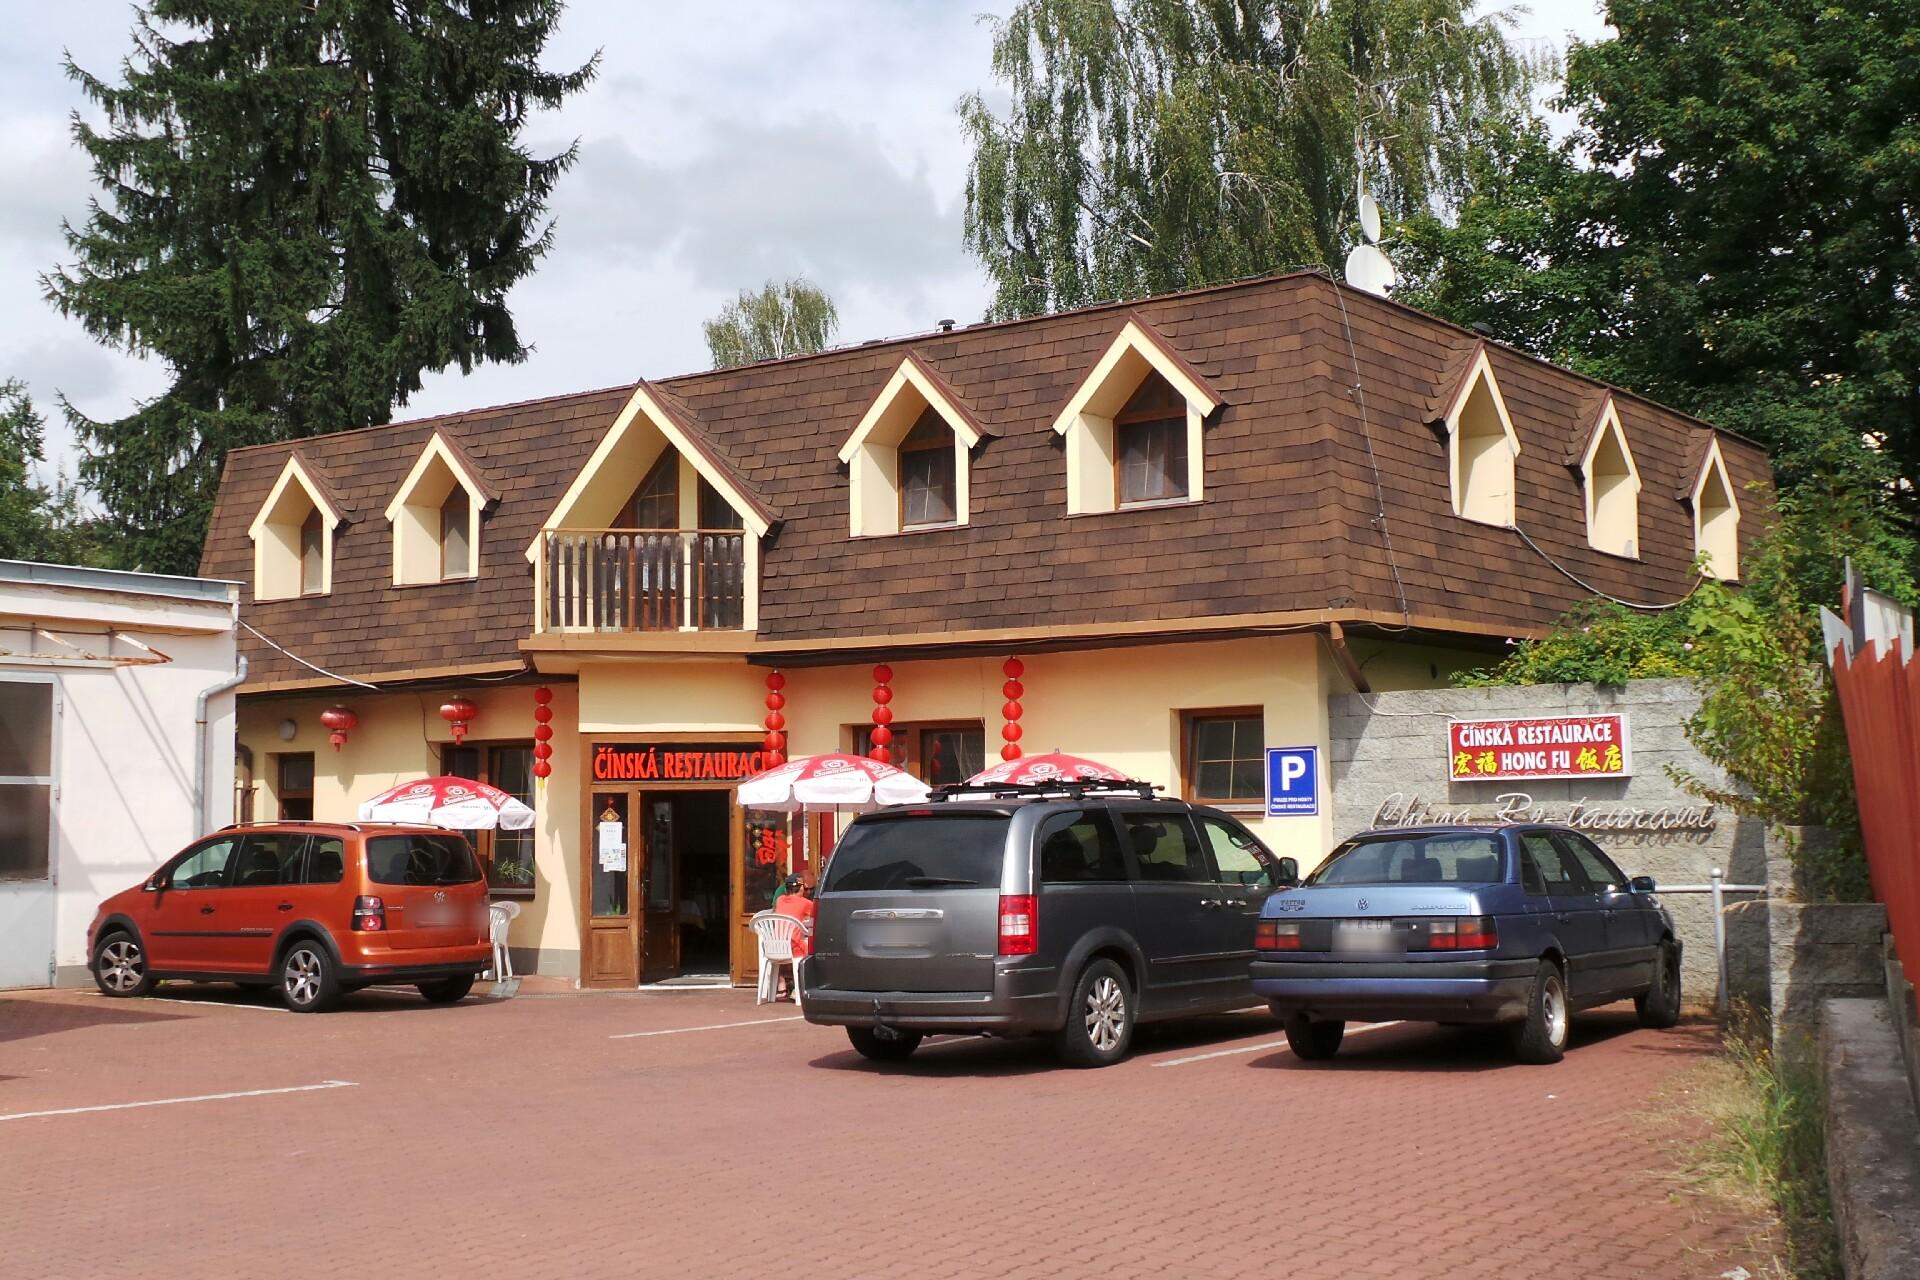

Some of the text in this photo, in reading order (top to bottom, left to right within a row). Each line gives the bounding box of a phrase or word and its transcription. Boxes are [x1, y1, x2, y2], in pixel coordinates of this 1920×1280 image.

[1459, 723, 1613, 748] ČÍNSKÁ RESTAURACE
[594, 747, 659, 779] ČÍNSKÁ
[1281, 755, 1306, 791] P
[1501, 752, 1547, 771] HONG
[1552, 750, 1571, 769] FU
